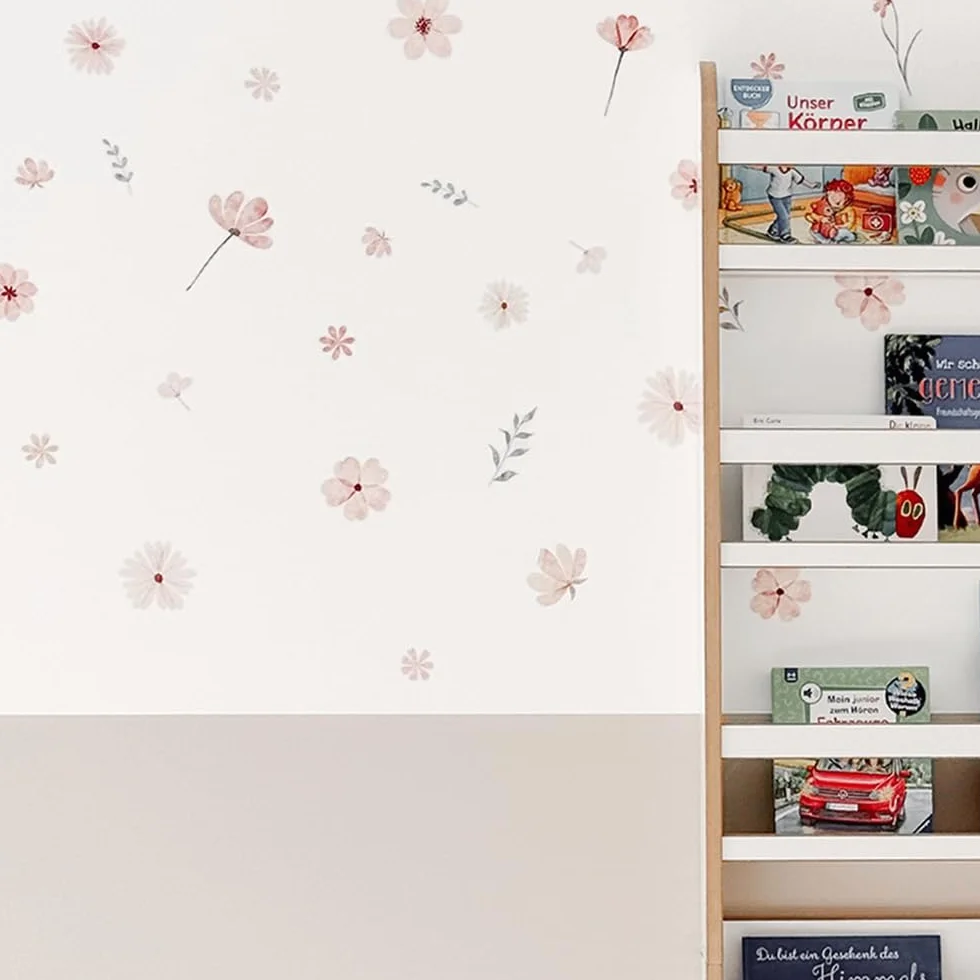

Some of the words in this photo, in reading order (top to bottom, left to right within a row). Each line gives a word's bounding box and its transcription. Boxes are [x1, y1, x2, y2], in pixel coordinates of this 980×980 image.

[787, 95, 834, 109] Unser
[936, 359, 954, 370] Wir
[827, 695, 850, 703] Mein
[852, 695, 880, 704] junior
[851, 705, 879, 714] Hören
[756, 947, 775, 961] Du
[777, 946, 799, 961] bist
[800, 950, 820, 961] ein
[822, 946, 878, 965] Geschenk
[879, 946, 900, 960] des
